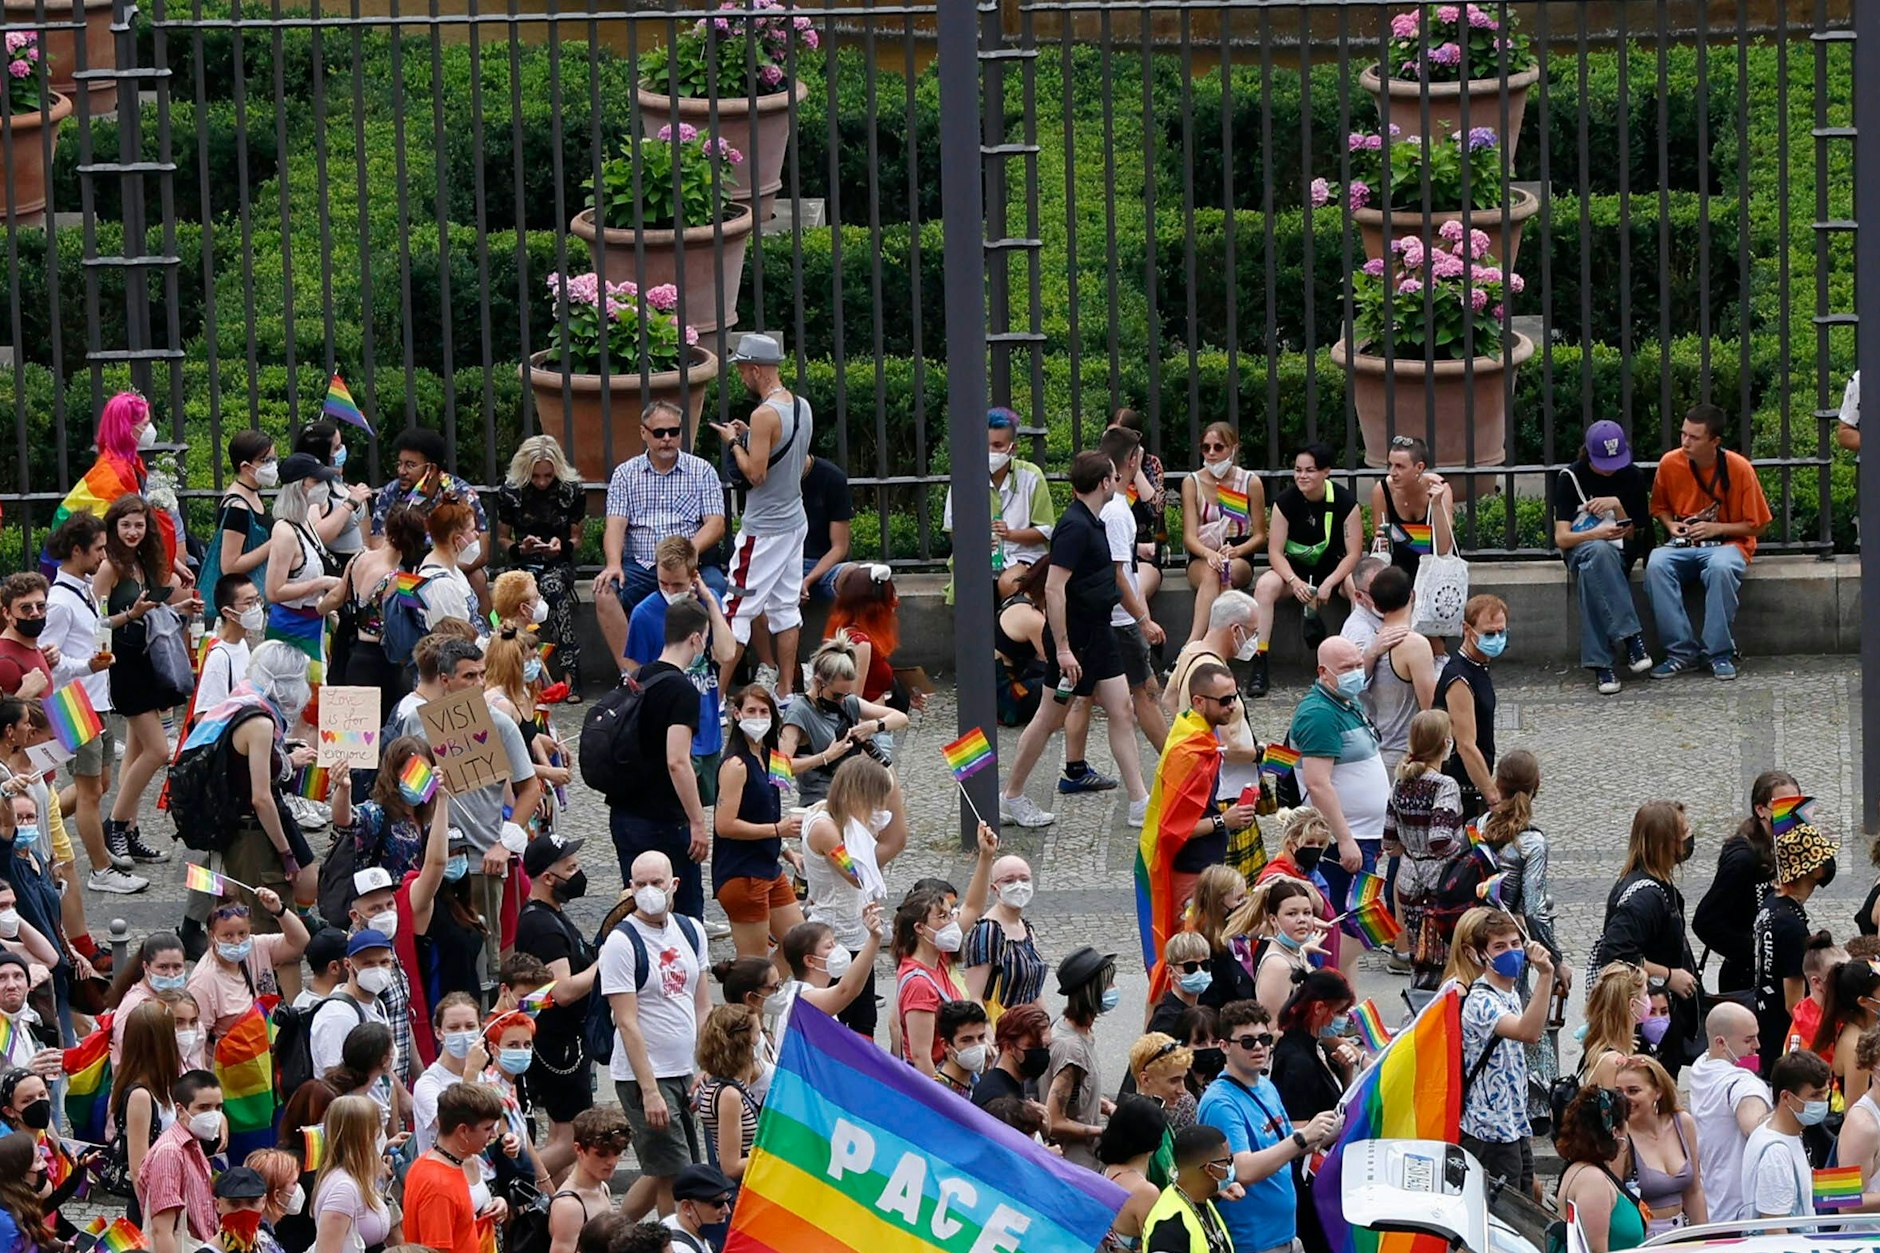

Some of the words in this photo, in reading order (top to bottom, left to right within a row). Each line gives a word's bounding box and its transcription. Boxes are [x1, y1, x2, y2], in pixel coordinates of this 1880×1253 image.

[326, 688, 364, 706] Love
[326, 713, 338, 726] is
[343, 708, 369, 730] for
[427, 701, 478, 733] VISI
[323, 748, 373, 761] everyone
[448, 734, 472, 758] BI
[445, 752, 498, 794] LITY
